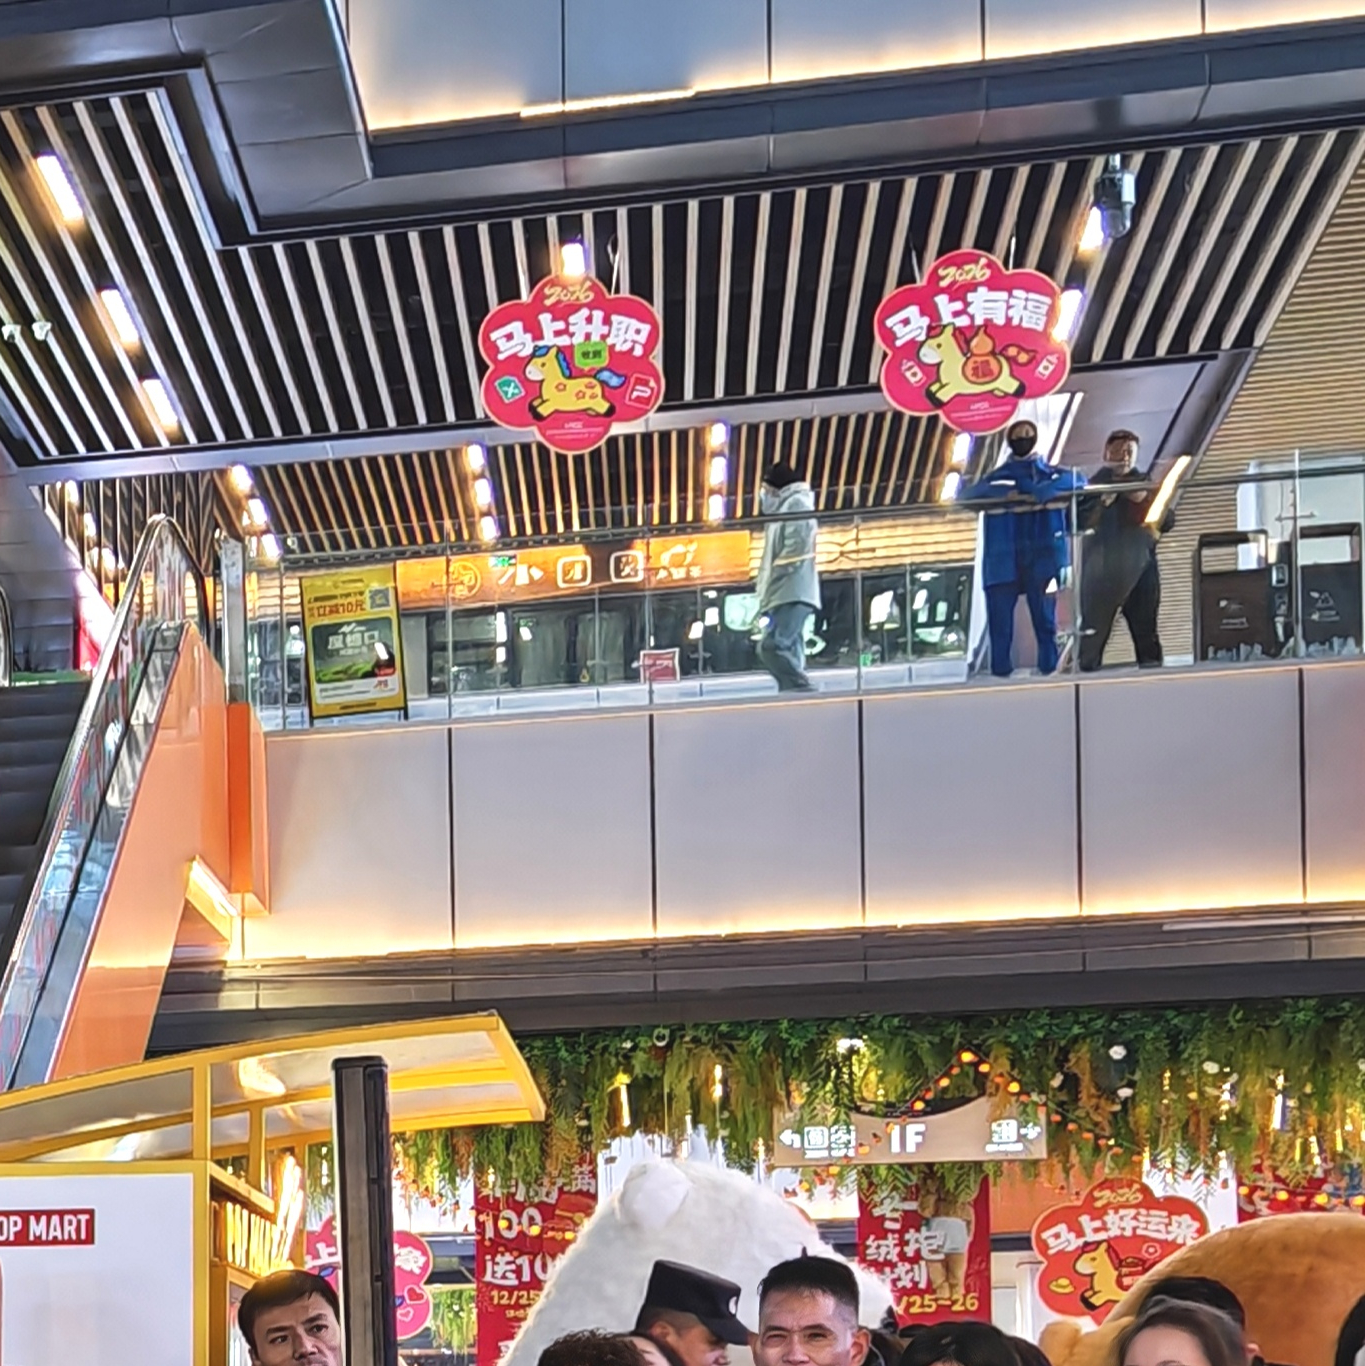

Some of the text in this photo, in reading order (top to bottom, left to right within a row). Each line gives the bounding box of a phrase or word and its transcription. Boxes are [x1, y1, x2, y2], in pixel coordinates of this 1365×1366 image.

[489, 307, 651, 361] 马上升职
[885, 286, 1052, 347] 马上有福
[29, 1213, 91, 1241] MART
[1040, 1208, 1201, 1256] 马上好运来
